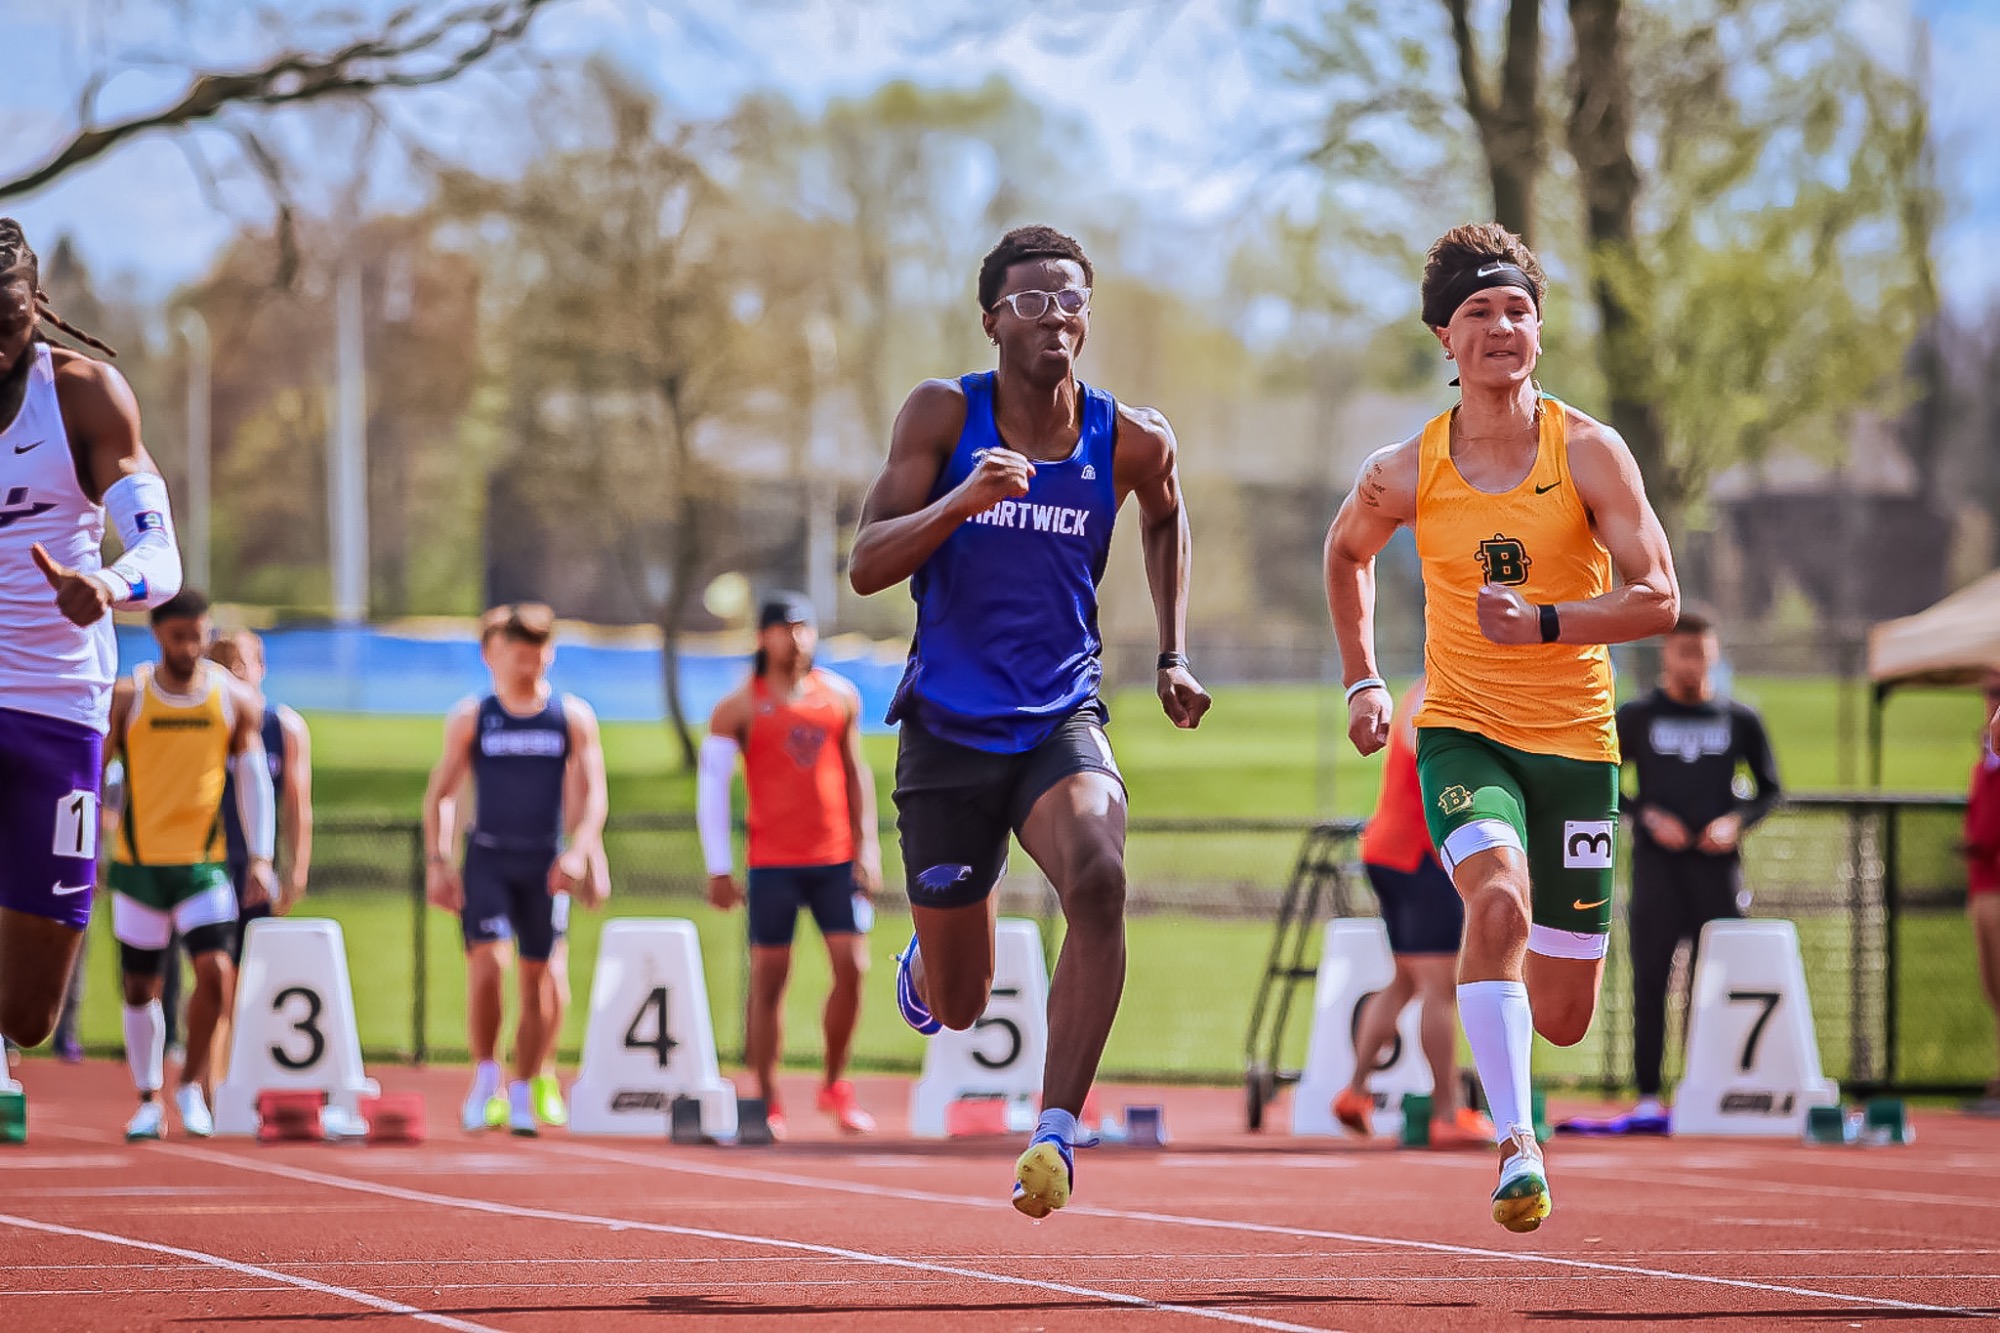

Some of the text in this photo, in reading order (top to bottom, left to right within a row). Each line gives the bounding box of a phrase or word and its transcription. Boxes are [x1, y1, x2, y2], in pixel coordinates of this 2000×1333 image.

[1475, 533, 1532, 586] B
[70, 796, 84, 853] 1
[1567, 832, 1612, 859] 3
[270, 986, 326, 1070] 3
[625, 987, 678, 1067] 4
[972, 987, 1022, 1070] 5
[1728, 990, 1780, 1071] 7
